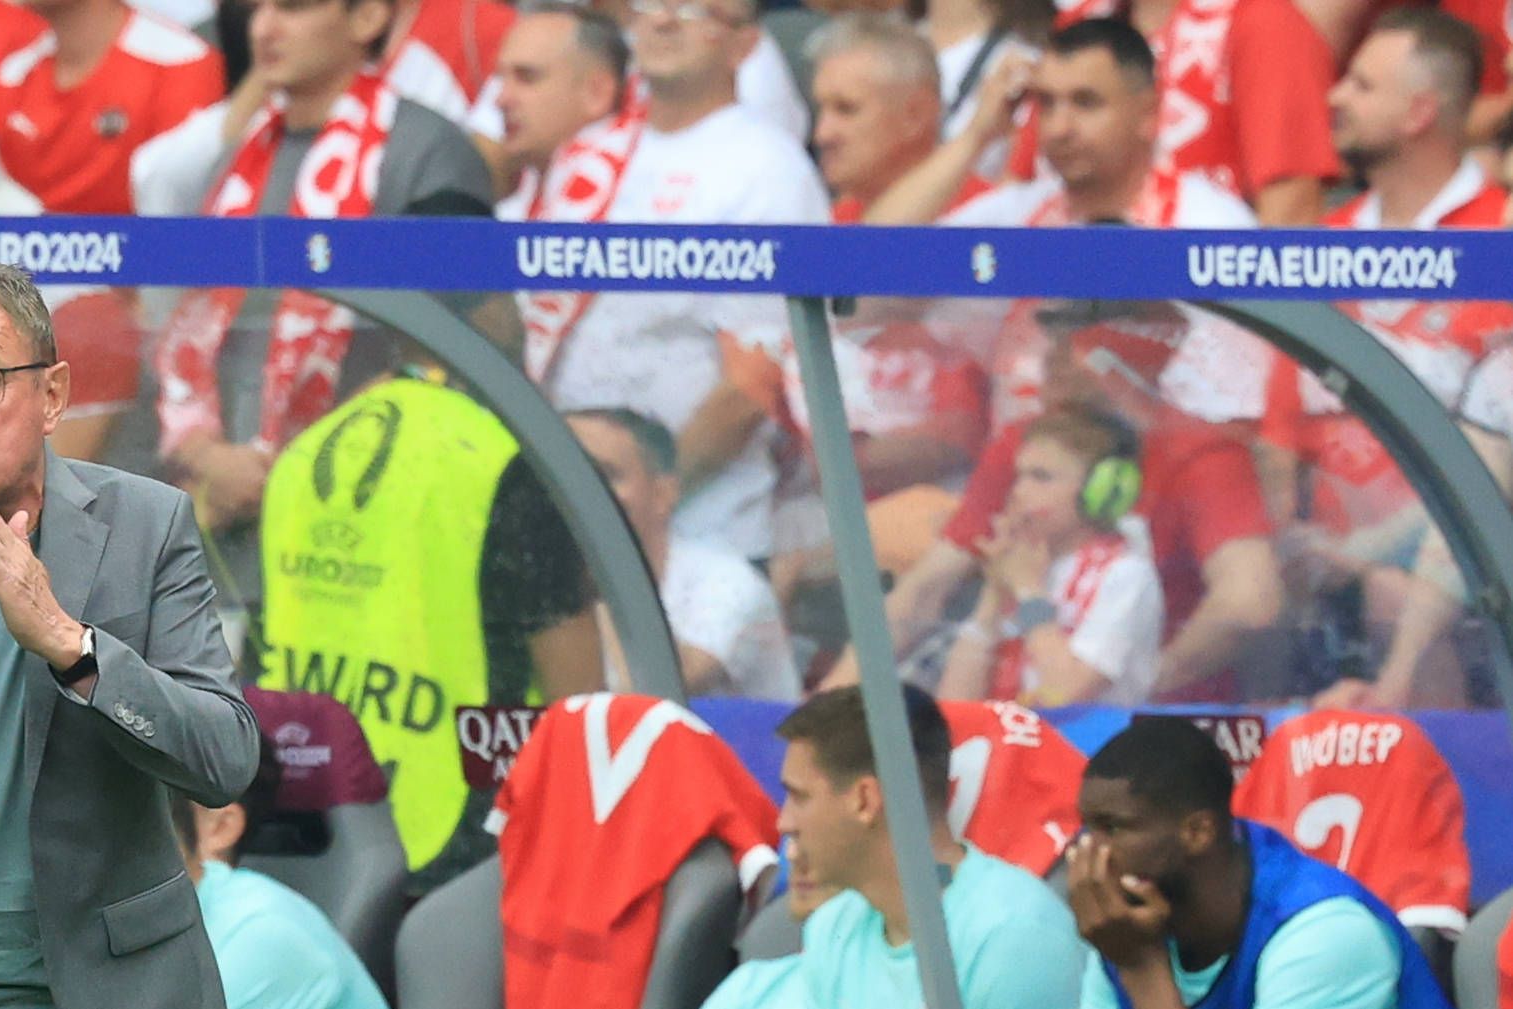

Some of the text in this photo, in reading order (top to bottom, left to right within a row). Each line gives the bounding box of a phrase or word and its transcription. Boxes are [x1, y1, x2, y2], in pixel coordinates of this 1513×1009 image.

[517, 236, 776, 281] UEFAEURO2024
[1188, 245, 1457, 288] UEFAEURO2024
[459, 709, 535, 762] QAT
